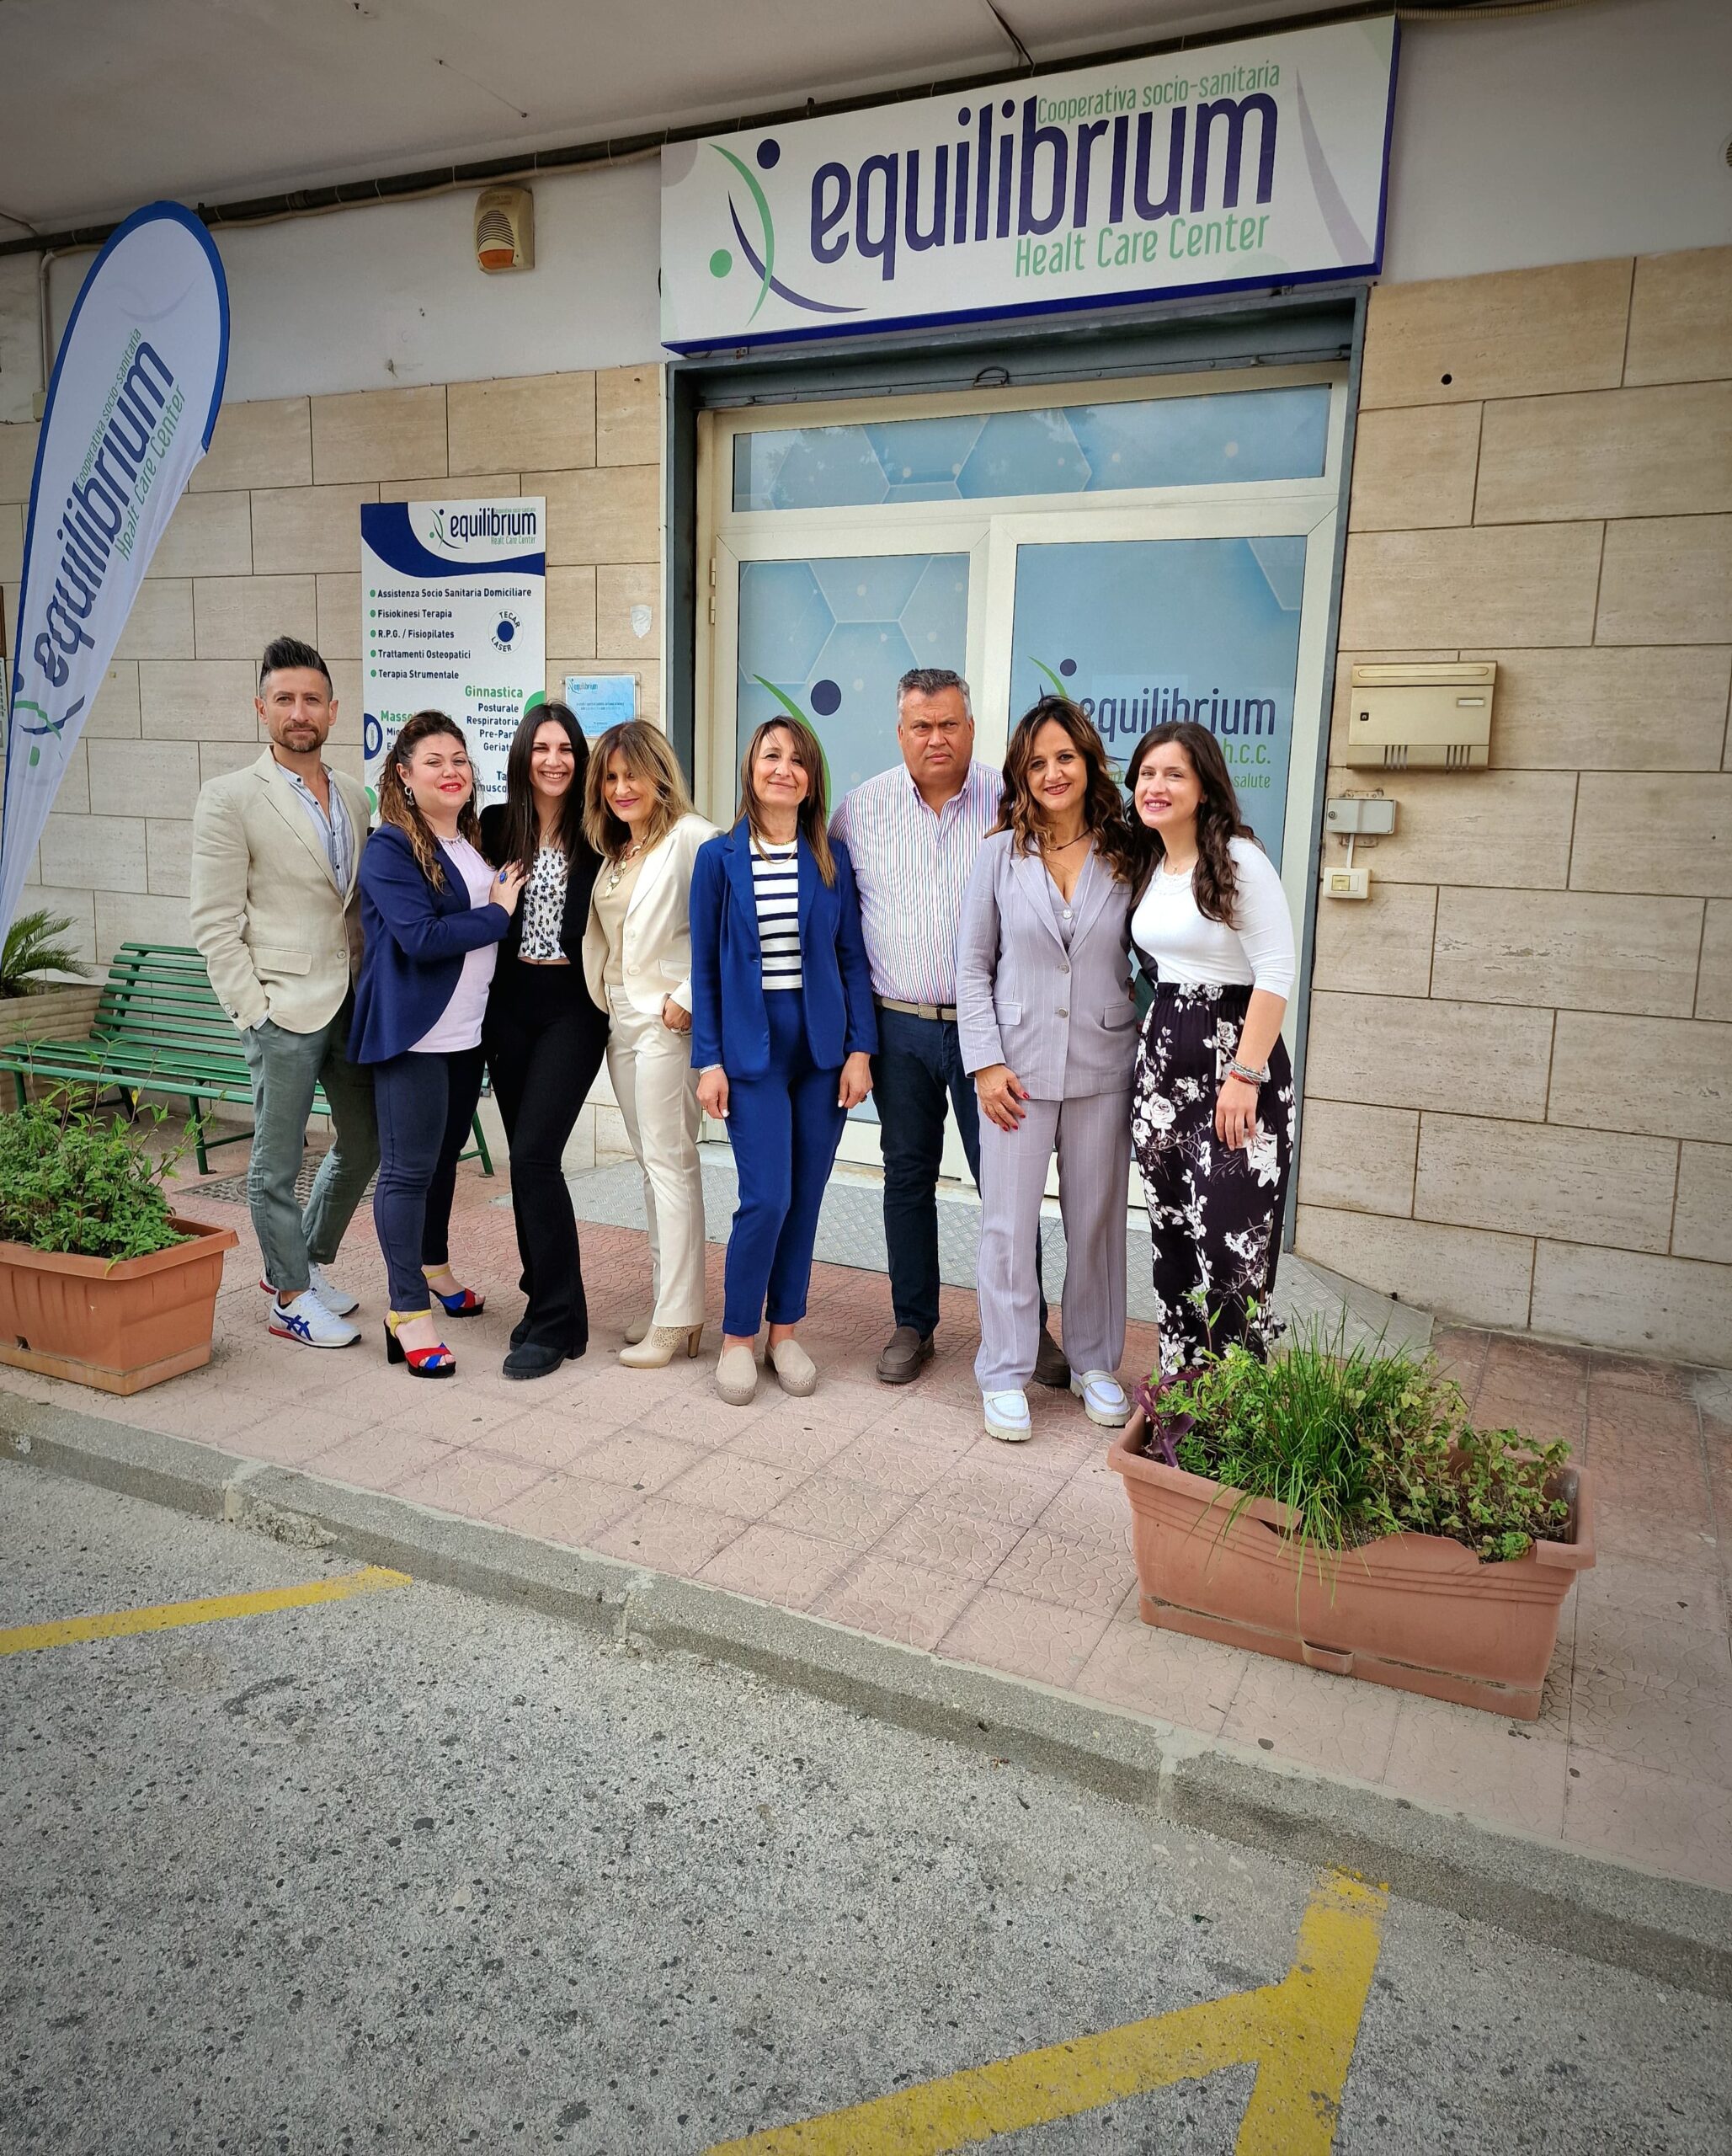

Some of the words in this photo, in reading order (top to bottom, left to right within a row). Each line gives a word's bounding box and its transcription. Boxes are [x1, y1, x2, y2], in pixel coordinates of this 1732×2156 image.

[1037, 85, 1137, 125] Cooperativa
[1142, 60, 1280, 108] socio-sanitaria
[810, 93, 1278, 281] equilibrium
[1015, 231, 1085, 278] Healt
[1097, 227, 1159, 268] Care
[1169, 213, 1271, 259] Center
[76, 419, 106, 491] Cooperativa
[102, 327, 142, 421] socio-sanitaria
[115, 504, 140, 562] Healt
[134, 457, 157, 505] Care
[150, 384, 186, 459] Center
[34, 341, 174, 688] equilibrium
[450, 507, 536, 543] equilibrium
[377, 589, 420, 598] Assistenza
[421, 588, 443, 598] Socio
[445, 588, 482, 597] Sanitaria
[483, 587, 532, 597] Domiciliare
[377, 609, 420, 618] Fisiokinesi
[422, 609, 452, 620] Terapia
[498, 611, 520, 628] TECAR
[378, 629, 401, 638] R.P.G.
[408, 629, 455, 640] Fisiopilates
[491, 636, 512, 652] LASER
[378, 649, 424, 659] Trattamenti
[426, 649, 471, 661] Osteopatici
[378, 669, 408, 680] Terapia
[408, 670, 460, 680] Strumentale
[465, 685, 523, 698] Ginnastica
[477, 702, 519, 712] Posturale
[466, 715, 520, 727] Respiratoria
[479, 728, 515, 739] Pre-Par
[483, 742, 511, 752] Geriat
[1233, 772, 1271, 788] salute
